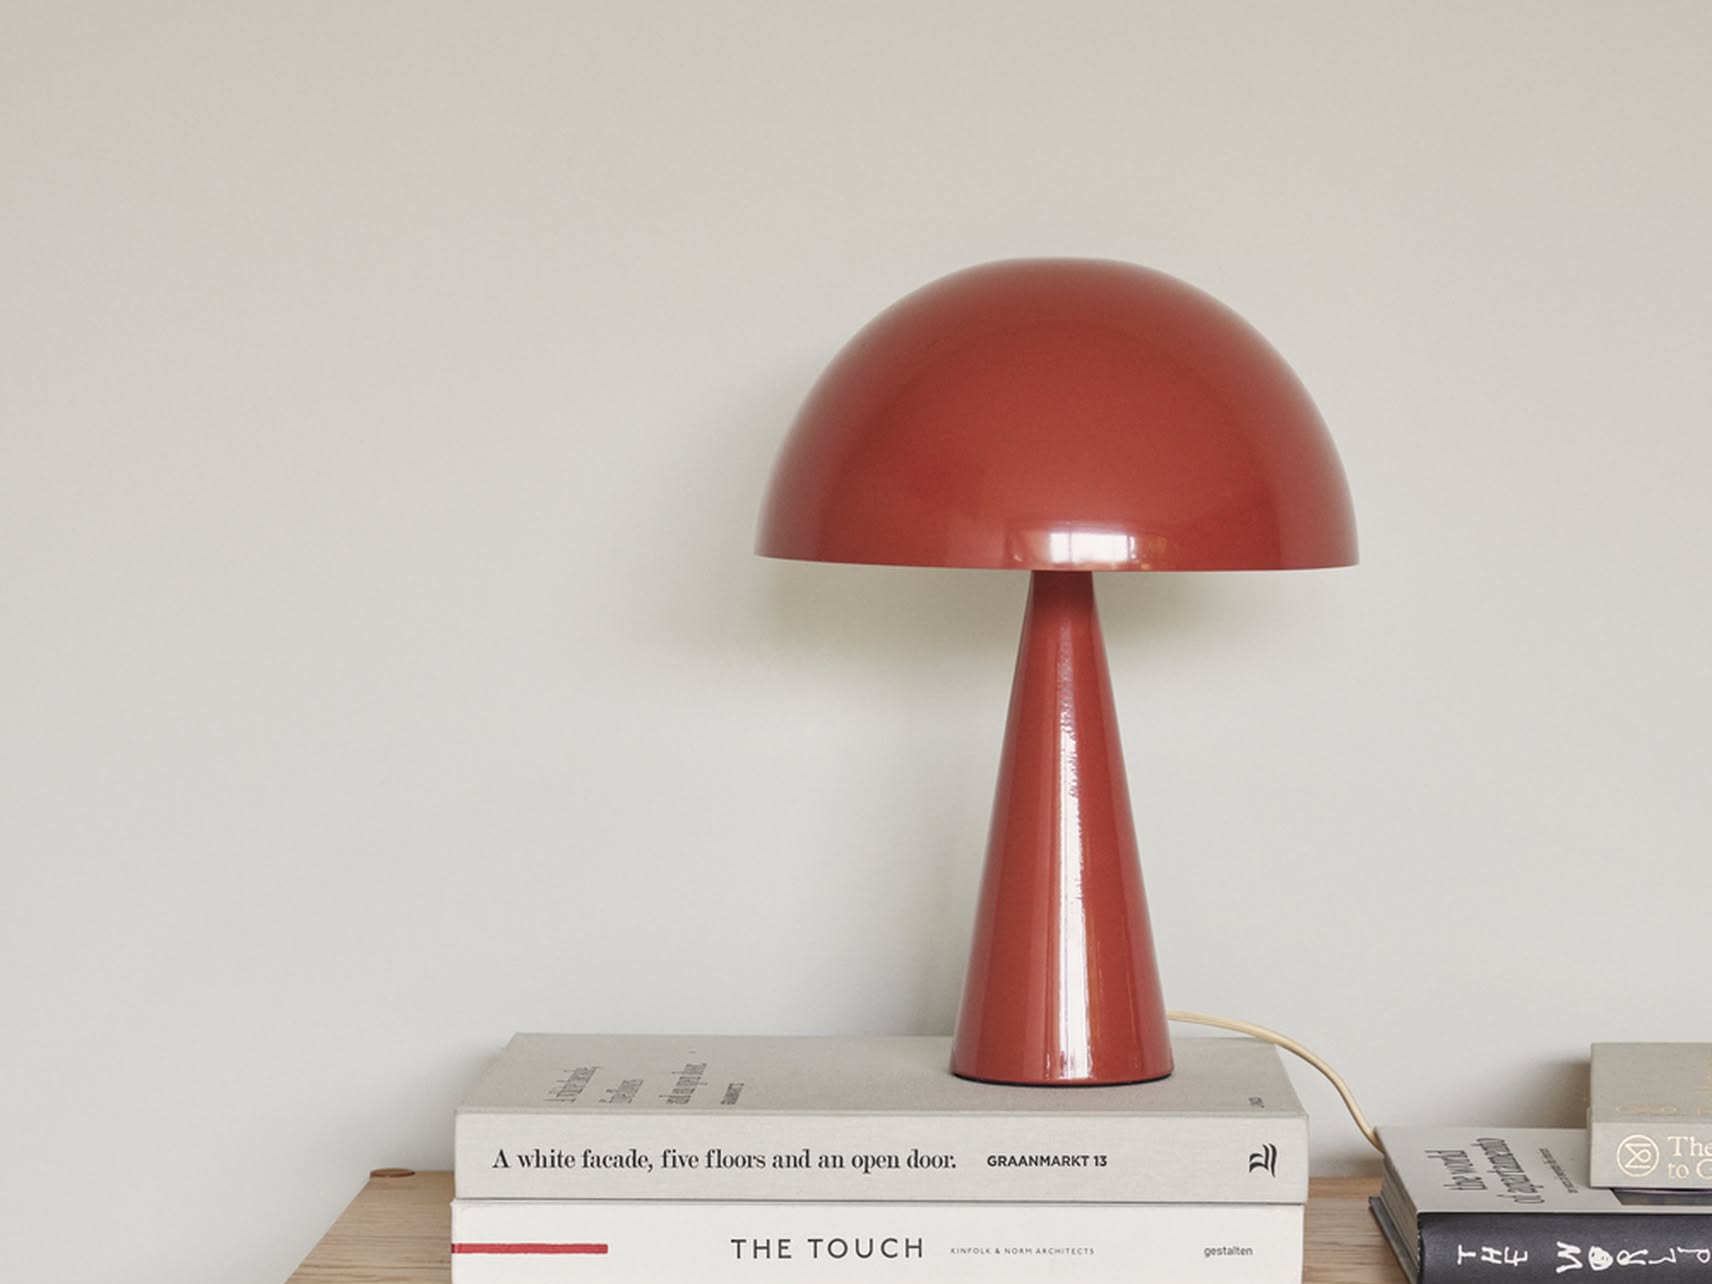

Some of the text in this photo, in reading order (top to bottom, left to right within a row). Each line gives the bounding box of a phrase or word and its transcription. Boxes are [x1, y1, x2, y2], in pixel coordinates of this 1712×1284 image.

[1667, 1135, 1712, 1157] The
[492, 1148, 957, 1174] A white facade, five floors and an open door.
[986, 1154, 1108, 1168] GRAANMARKT 13
[1667, 1162, 1690, 1179] to
[730, 1237, 923, 1260] THE TOUCH
[950, 1247, 1095, 1257] KINFOLK & NORM ARCHITECTS
[1203, 1245, 1254, 1258] gestalten
[1457, 1243, 1528, 1267] THE
